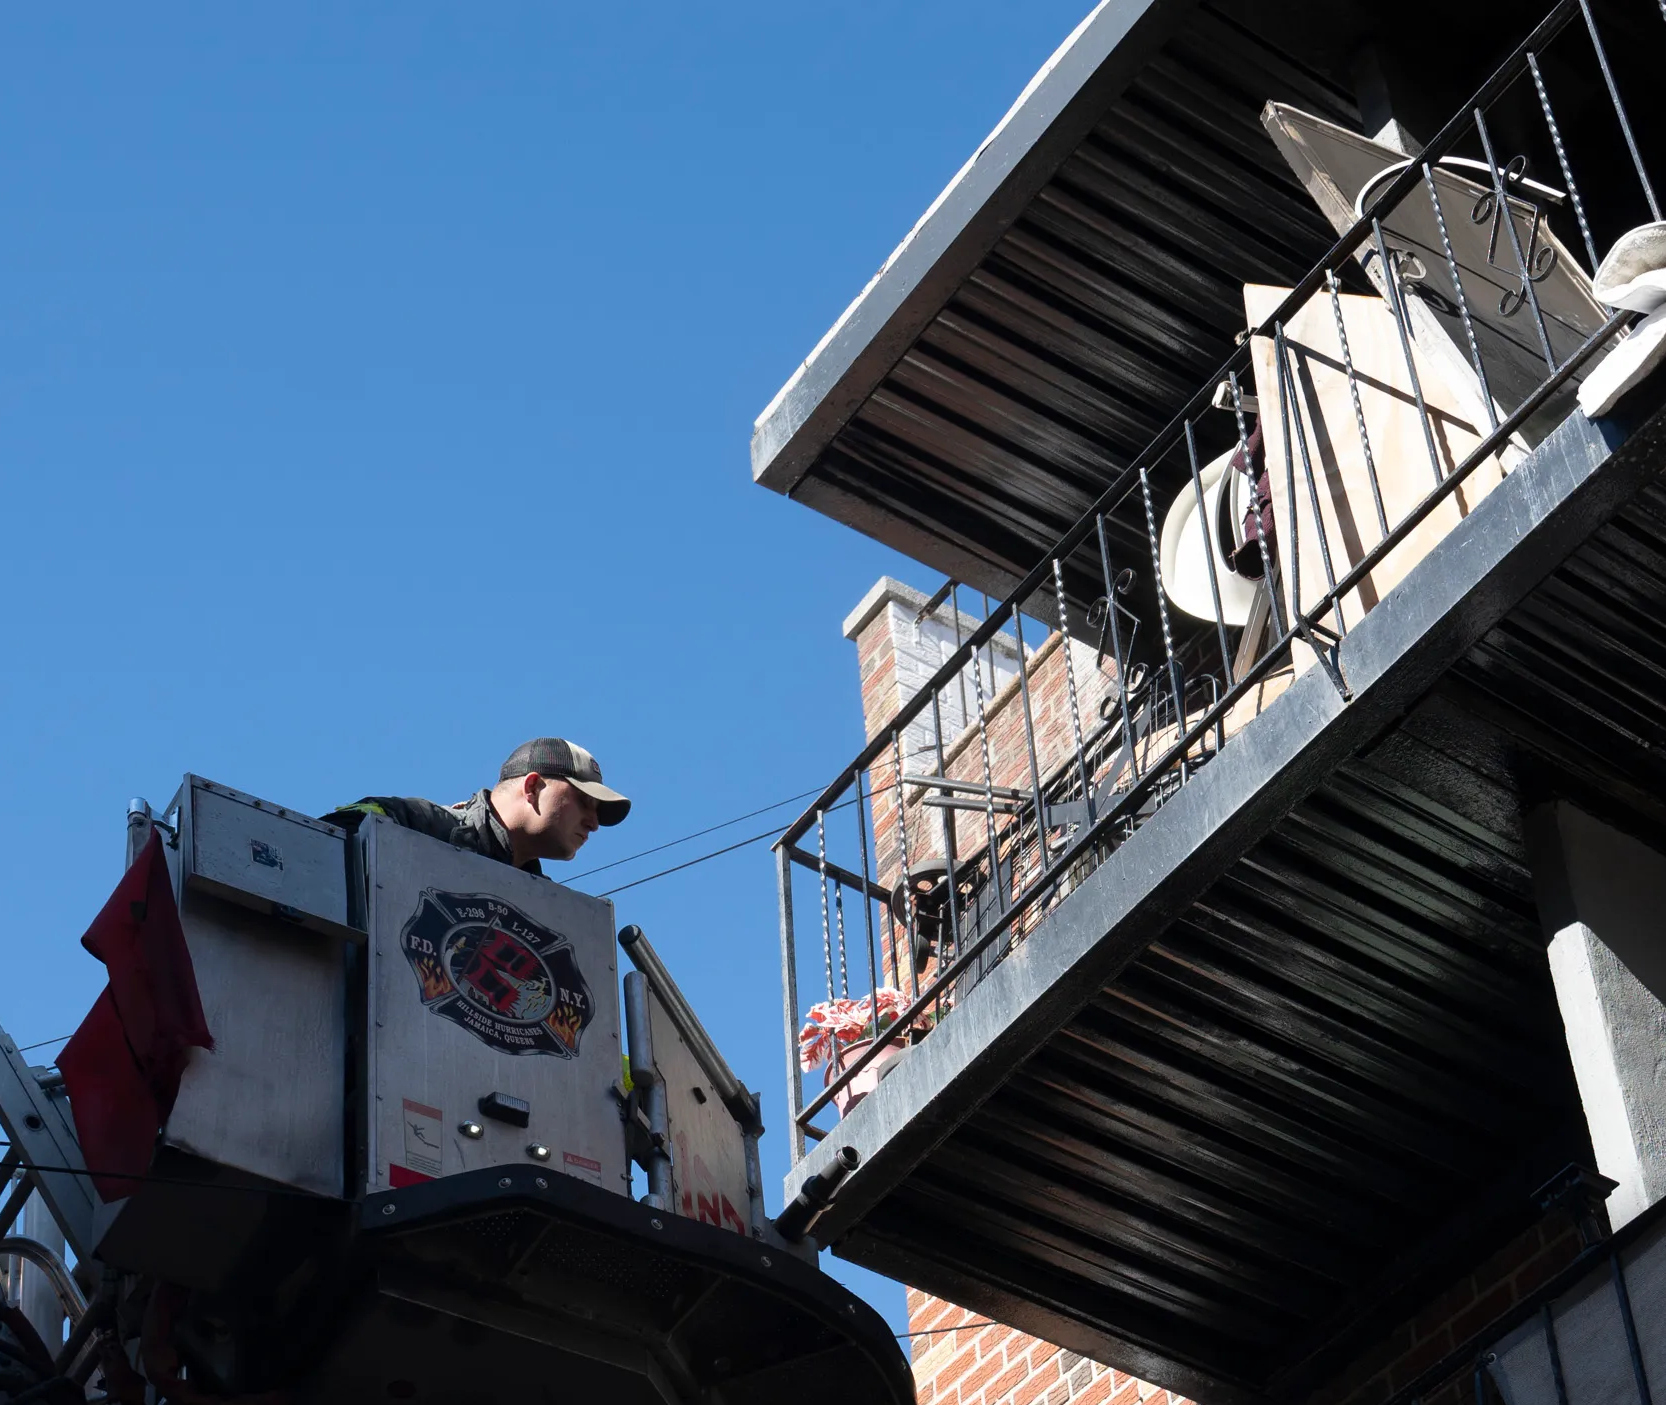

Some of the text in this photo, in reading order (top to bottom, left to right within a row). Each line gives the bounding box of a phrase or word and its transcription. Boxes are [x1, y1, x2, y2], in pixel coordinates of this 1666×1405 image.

[455, 901, 541, 944] E-298 B-50 L-127
[410, 935, 437, 956] F.D.
[559, 987, 586, 1008] N.Y.
[456, 1000, 543, 1036] HILLSIDE HURRICANES
[463, 1015, 535, 1046] JAMAICA, QUEENS
